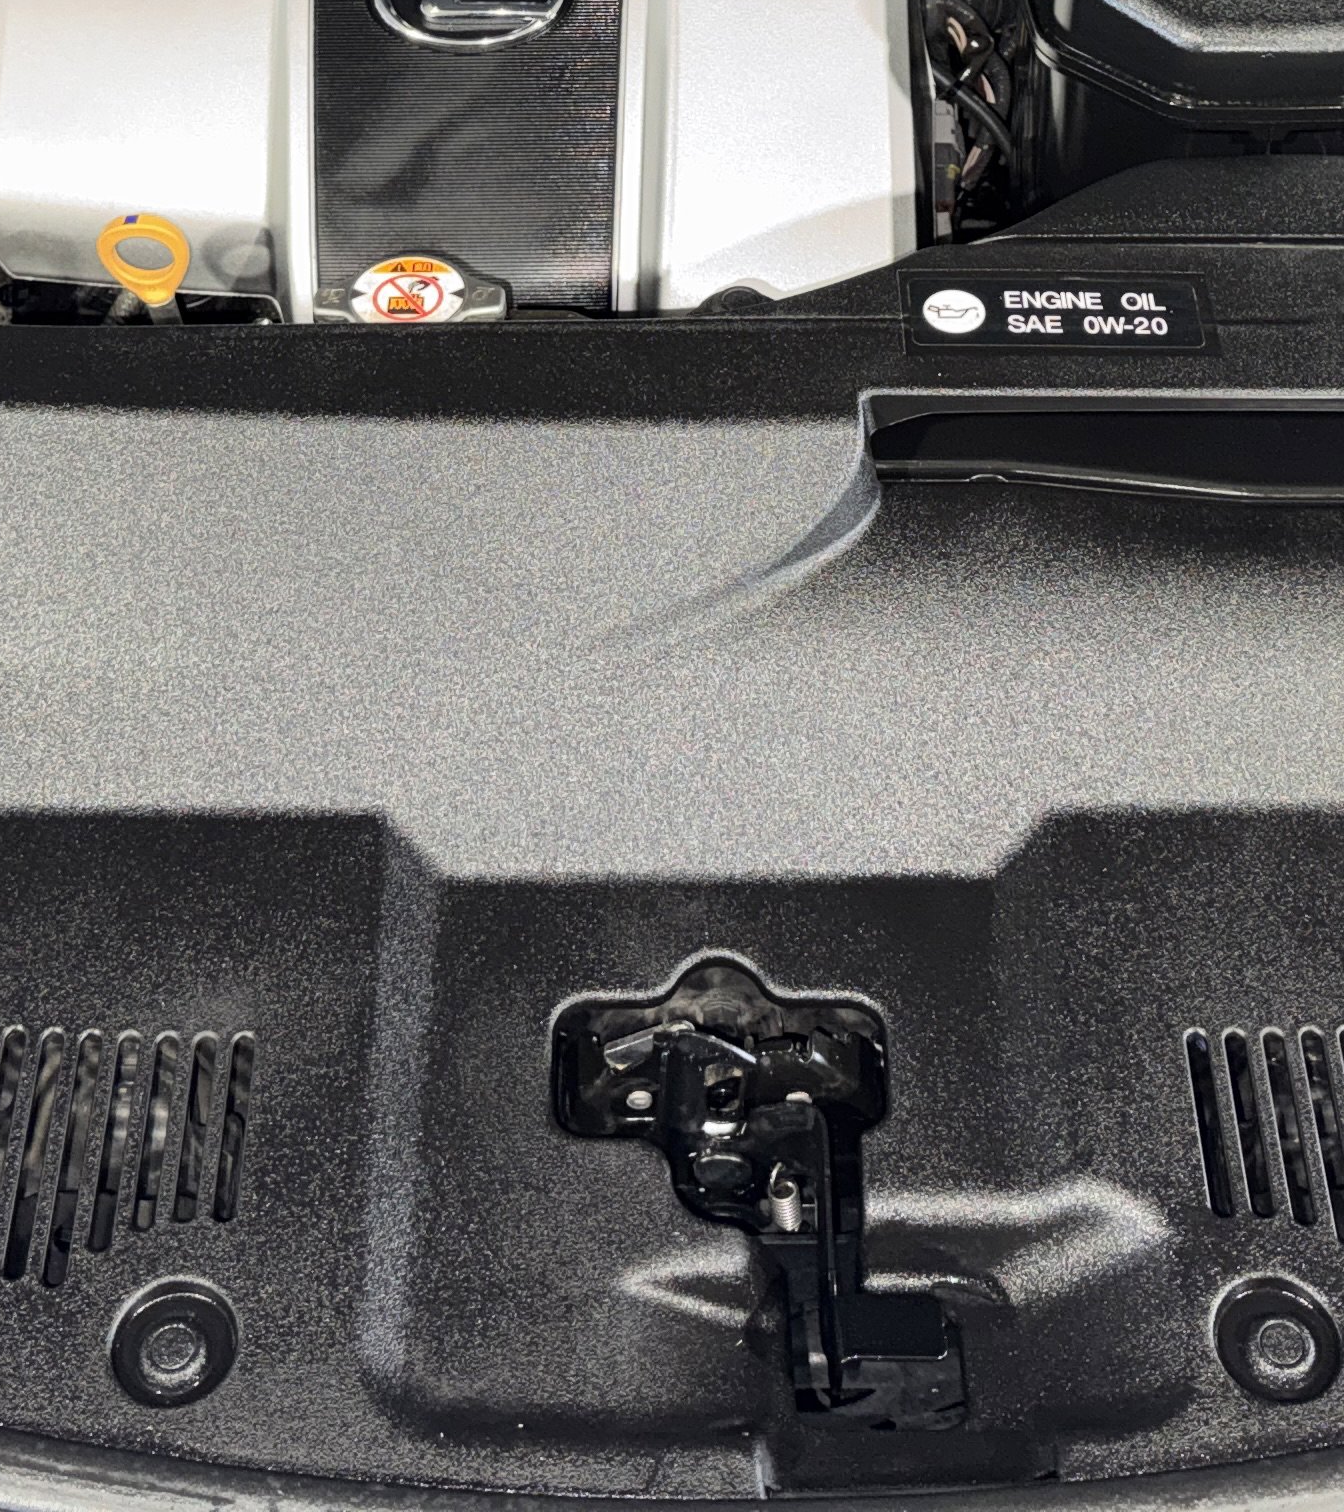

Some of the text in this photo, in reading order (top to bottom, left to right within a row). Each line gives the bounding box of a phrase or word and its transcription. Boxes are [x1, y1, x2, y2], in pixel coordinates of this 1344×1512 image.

[1003, 290, 1167, 311] ENGINE OIL
[1008, 315, 1169, 335] SAE 0W-20
